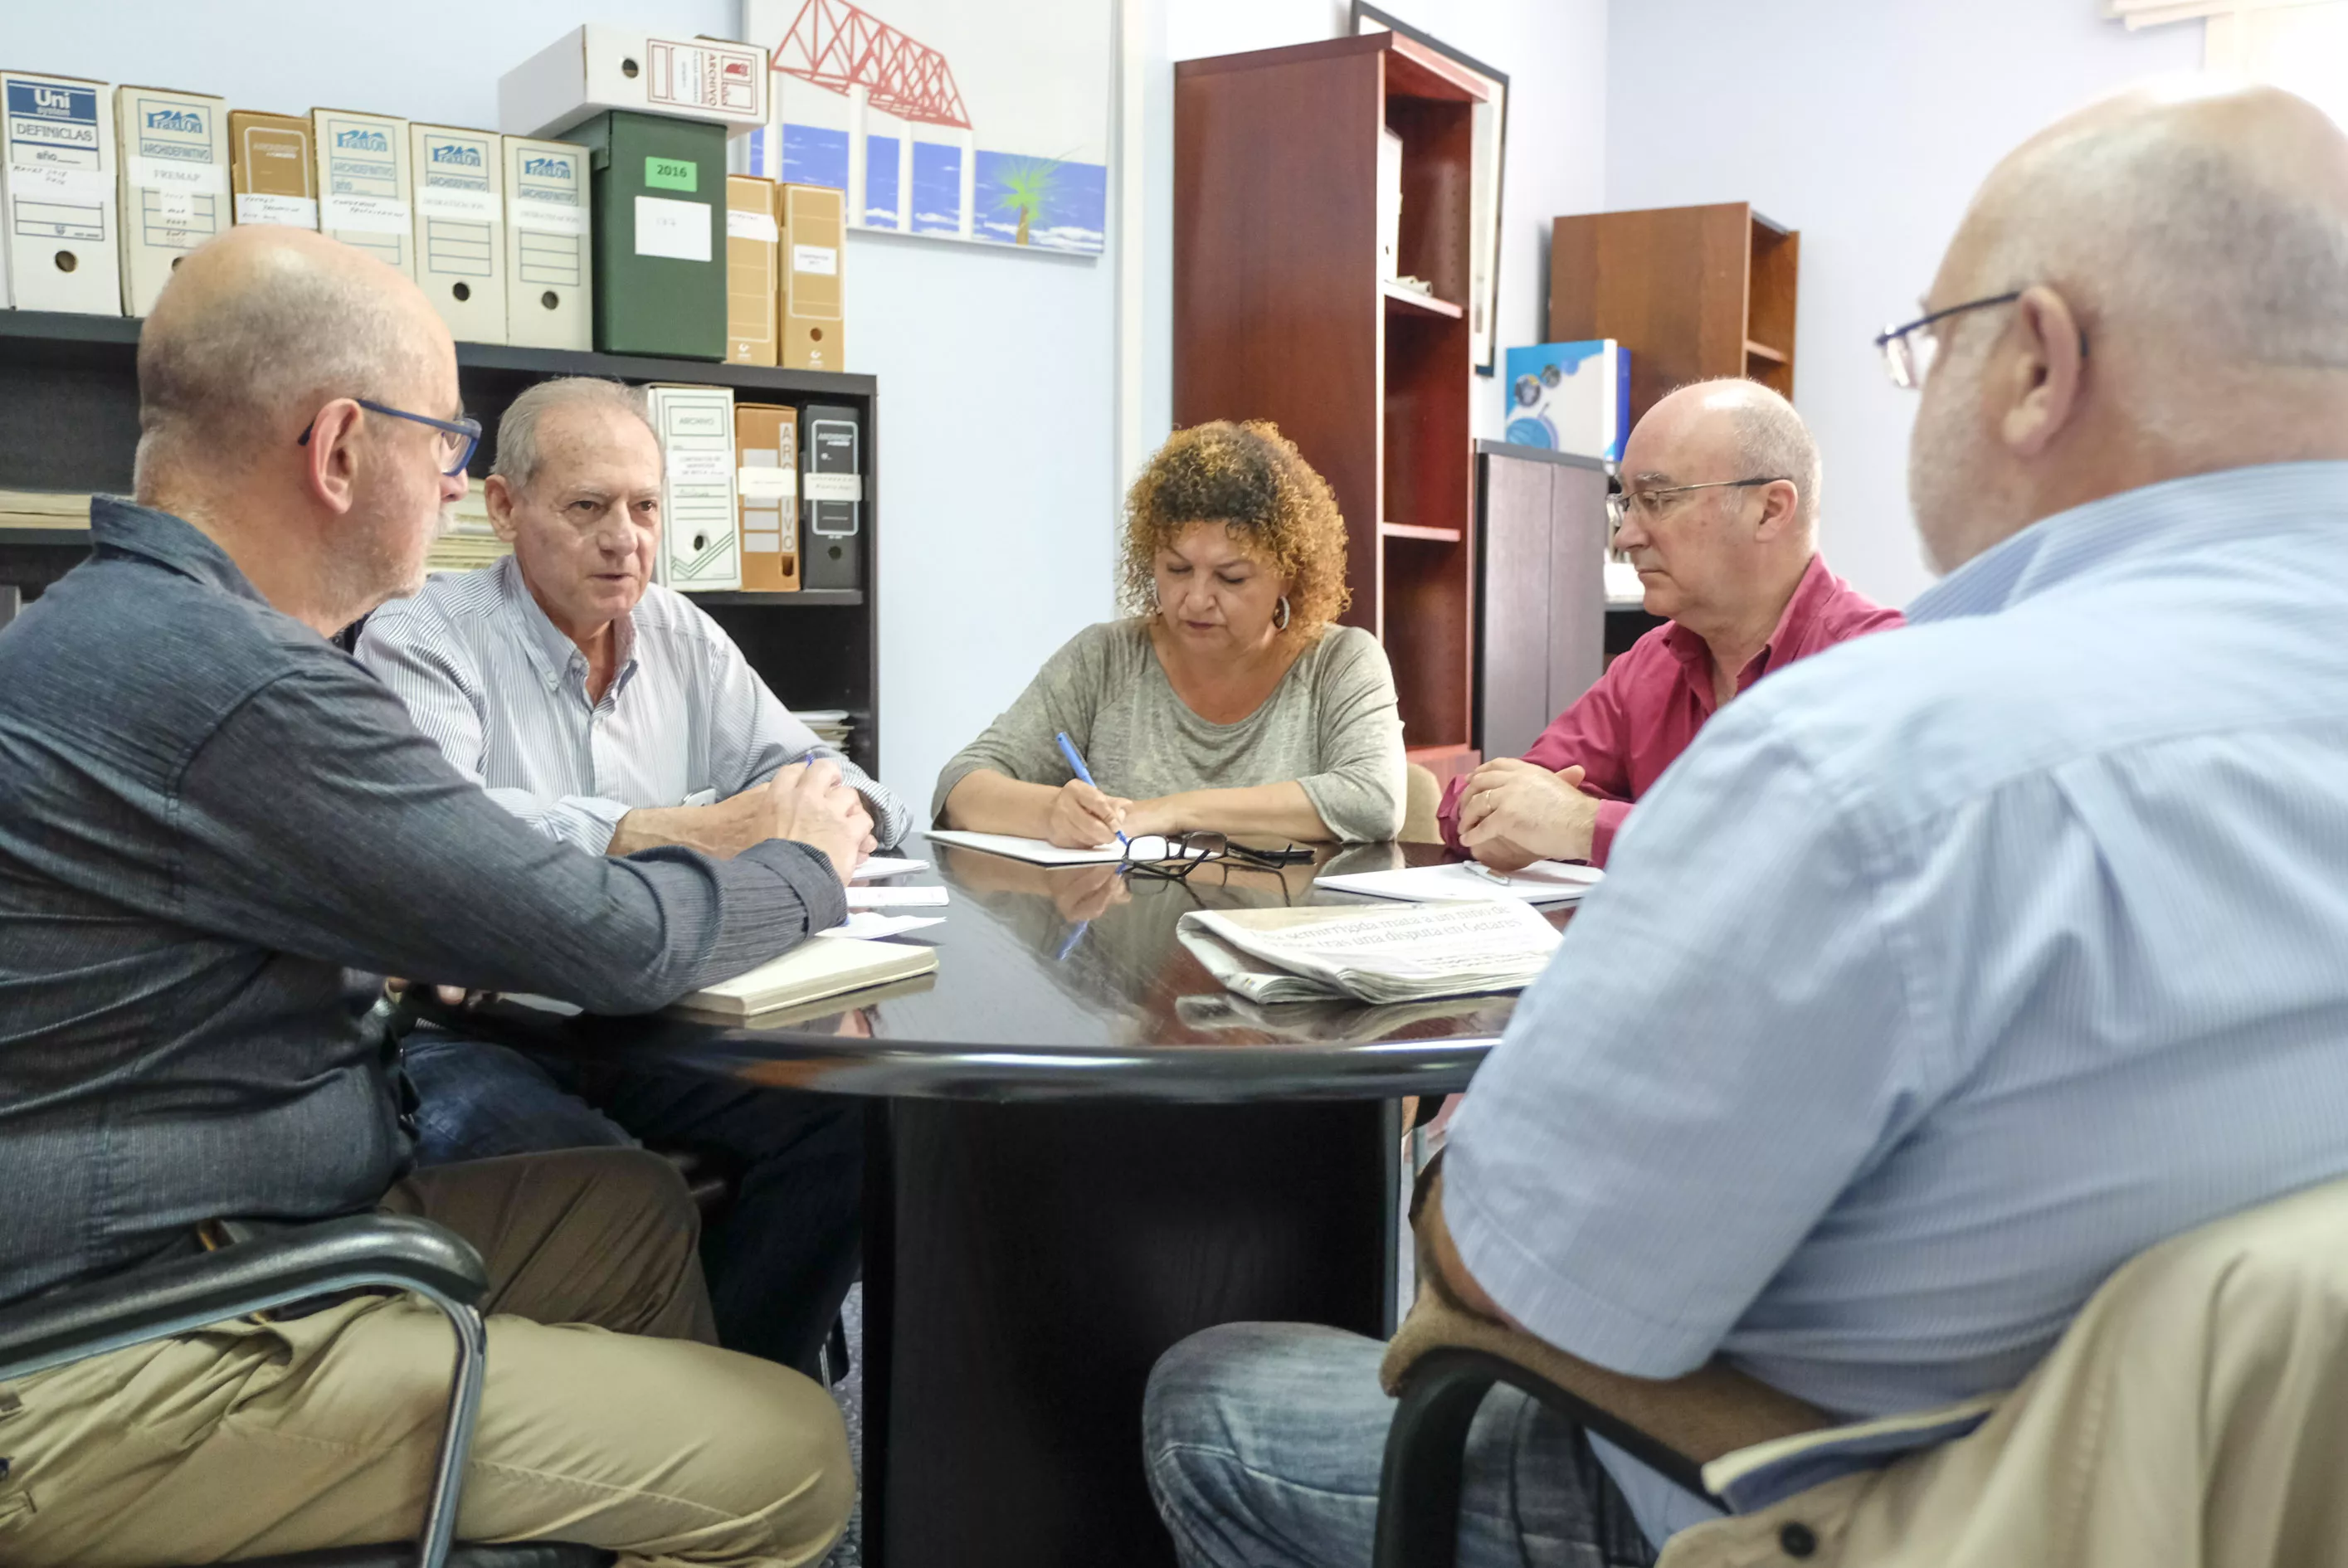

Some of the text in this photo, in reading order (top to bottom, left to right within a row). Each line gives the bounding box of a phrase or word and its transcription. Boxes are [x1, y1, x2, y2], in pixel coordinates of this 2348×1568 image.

[34, 88, 71, 109] Uni
[17, 123, 94, 142] DEFINICLAS
[36, 151, 57, 161] año
[657, 164, 687, 178] 2016
[782, 426, 794, 549] ARIVO
[1381, 918, 1420, 928] mata
[1435, 913, 1456, 922] un
[1491, 906, 1511, 914] de
[1353, 934, 1386, 945] una
[1385, 928, 1443, 941] disputa
